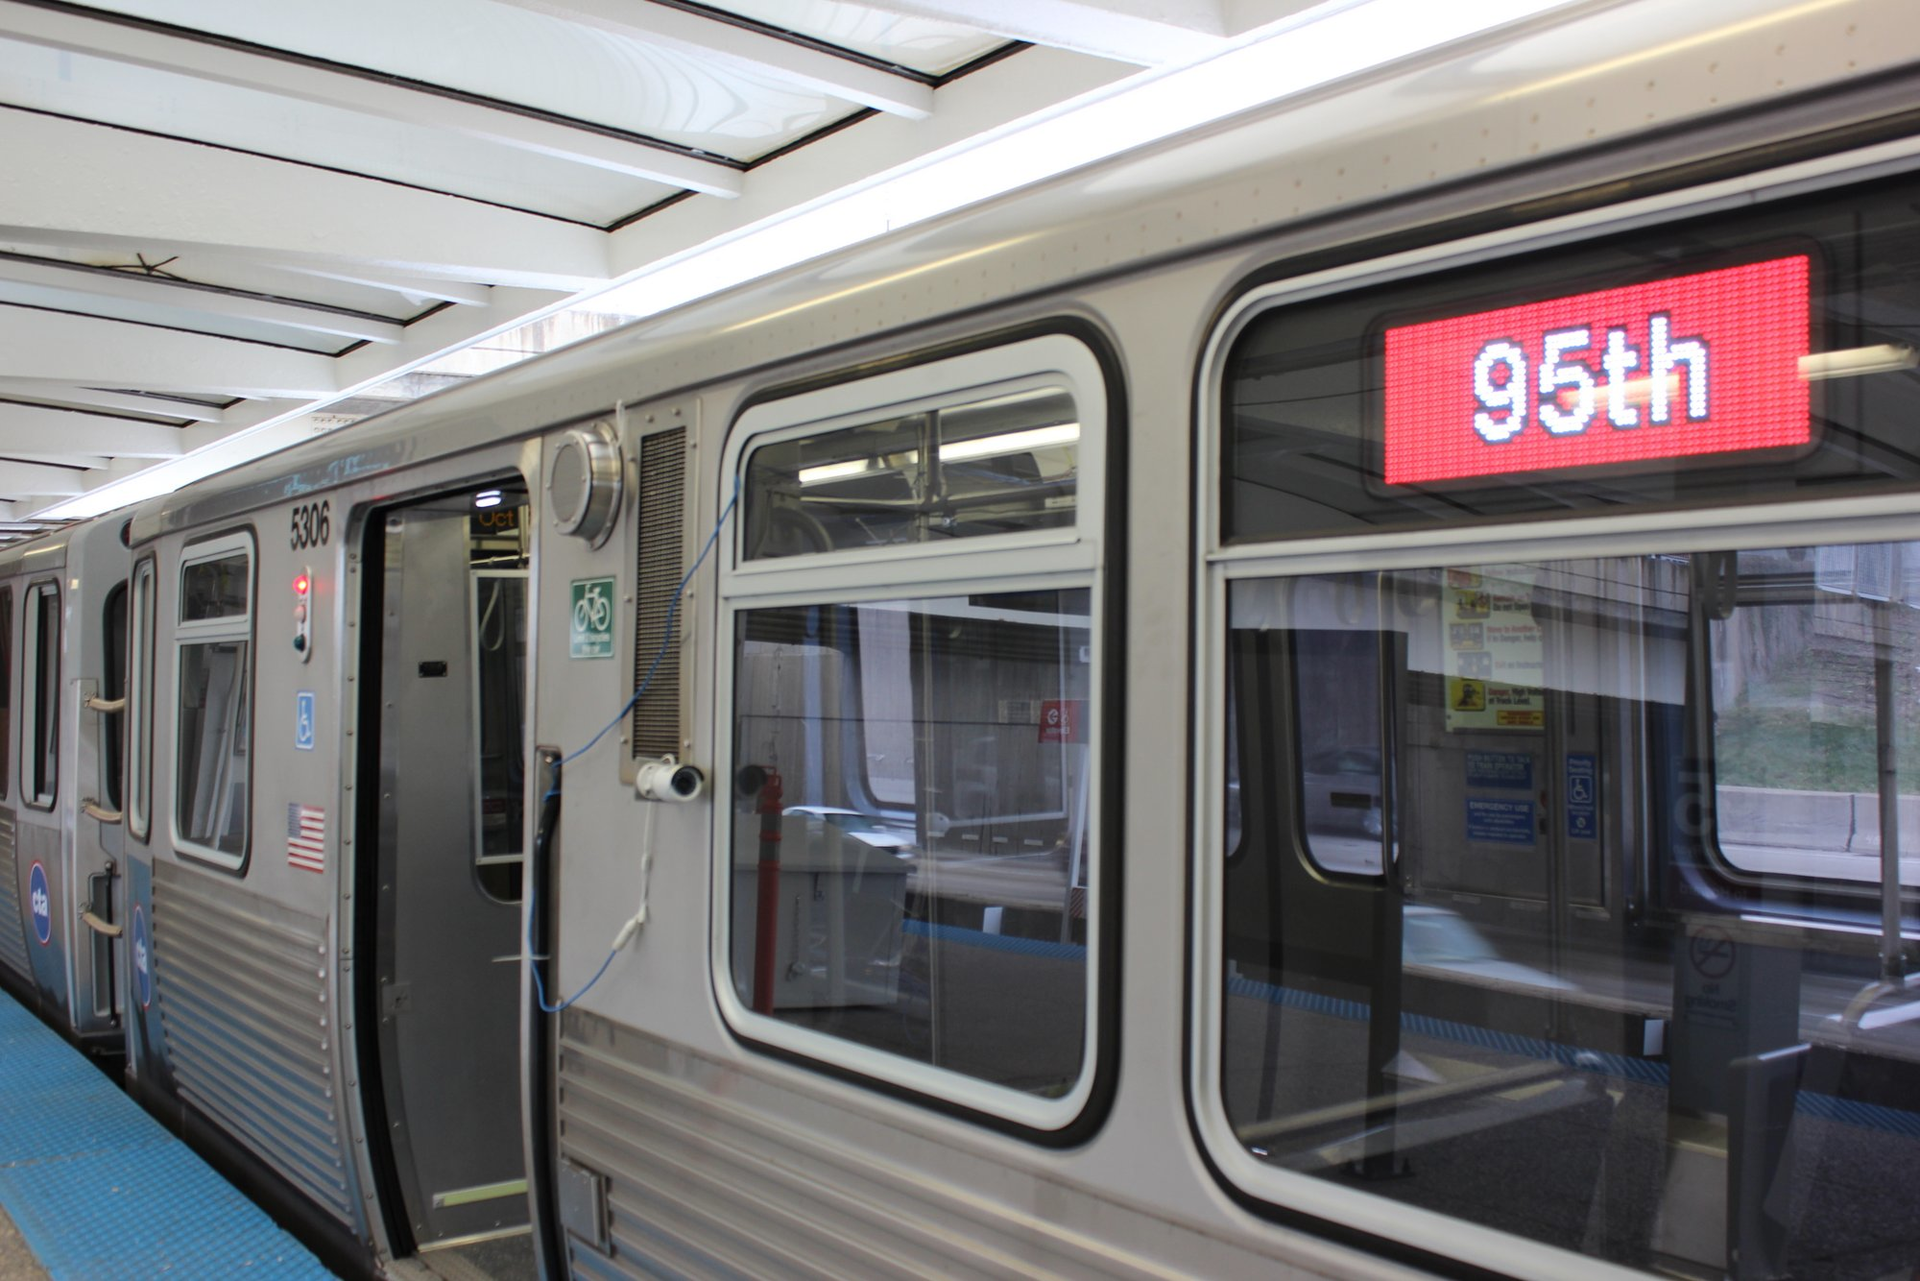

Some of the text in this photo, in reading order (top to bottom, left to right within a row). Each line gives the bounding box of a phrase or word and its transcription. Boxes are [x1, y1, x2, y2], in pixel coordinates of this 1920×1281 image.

[1474, 313, 1710, 445] 95th
[291, 499, 330, 551] 5306
[32, 888, 48, 918] cta
